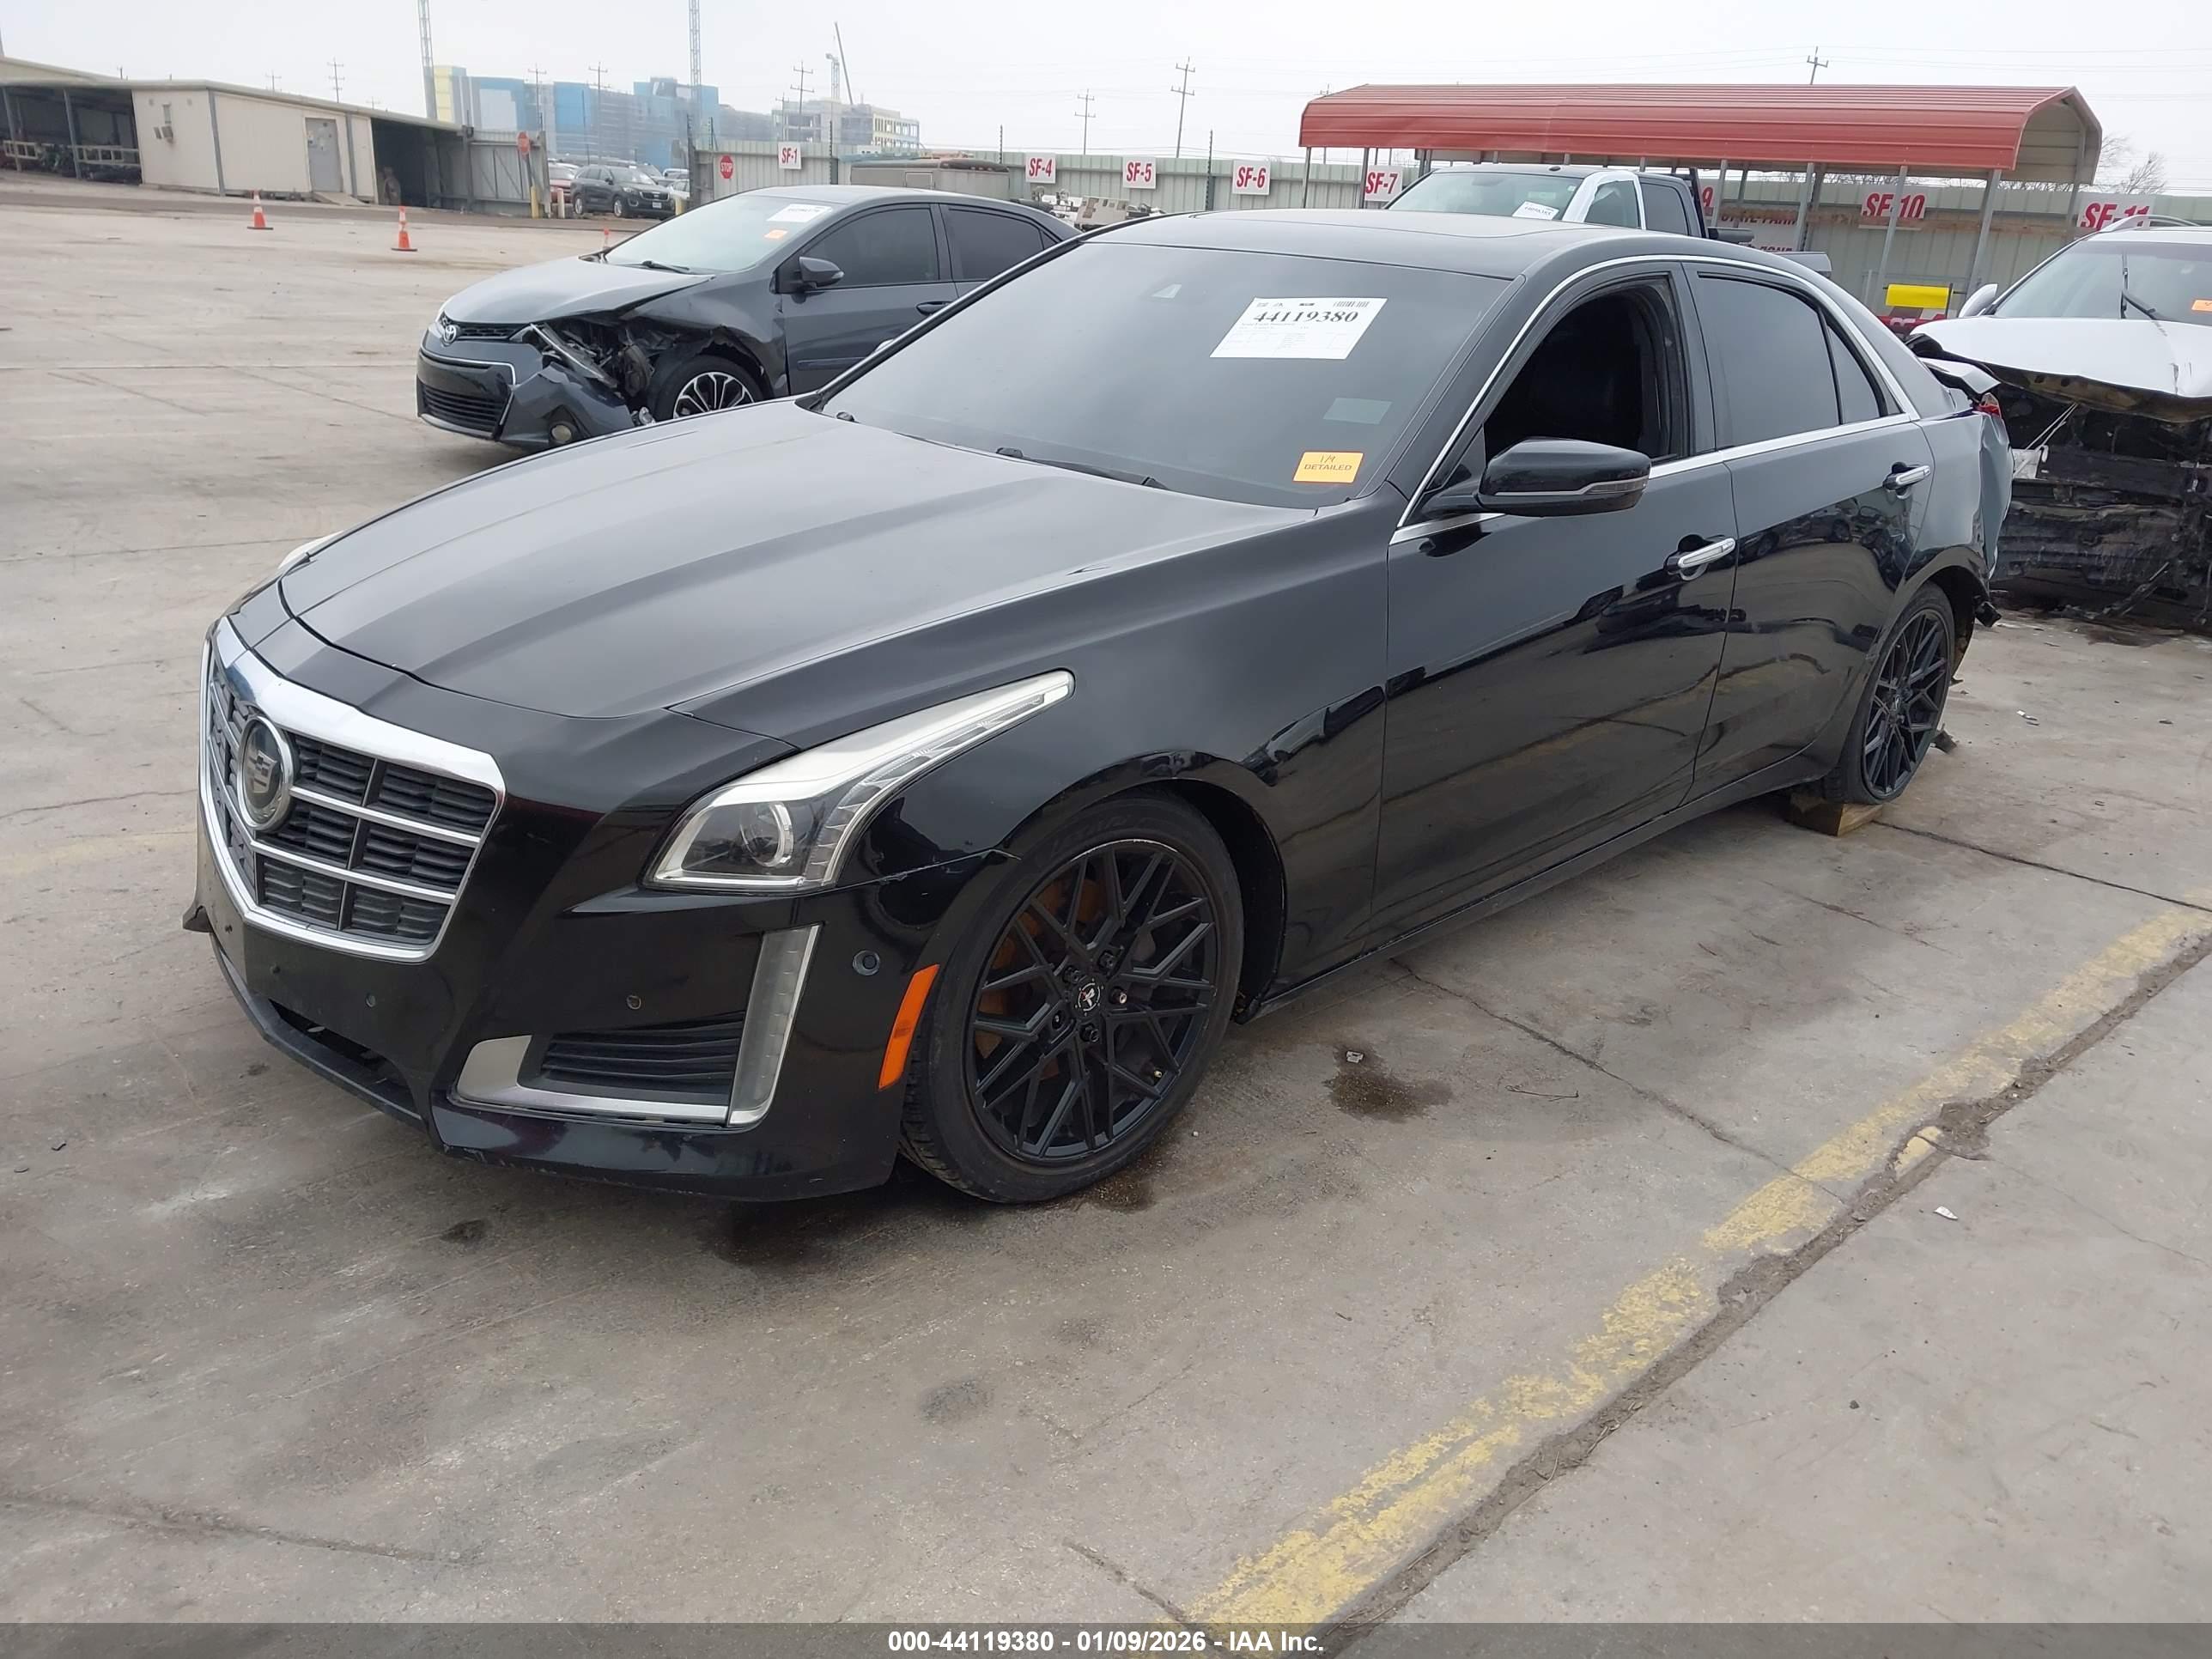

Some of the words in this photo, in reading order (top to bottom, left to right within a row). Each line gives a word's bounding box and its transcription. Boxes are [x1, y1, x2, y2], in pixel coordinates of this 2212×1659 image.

[782, 148, 798, 163] SF-1
[720, 161, 733, 173] STOP
[1030, 158, 1053, 177] SF-4
[1127, 161, 1152, 182] SF-5
[1237, 167, 1267, 189] SF-6
[1364, 172, 1398, 194] SF-7
[1863, 192, 1926, 218] SF10
[1253, 310, 1359, 323] 44119380
